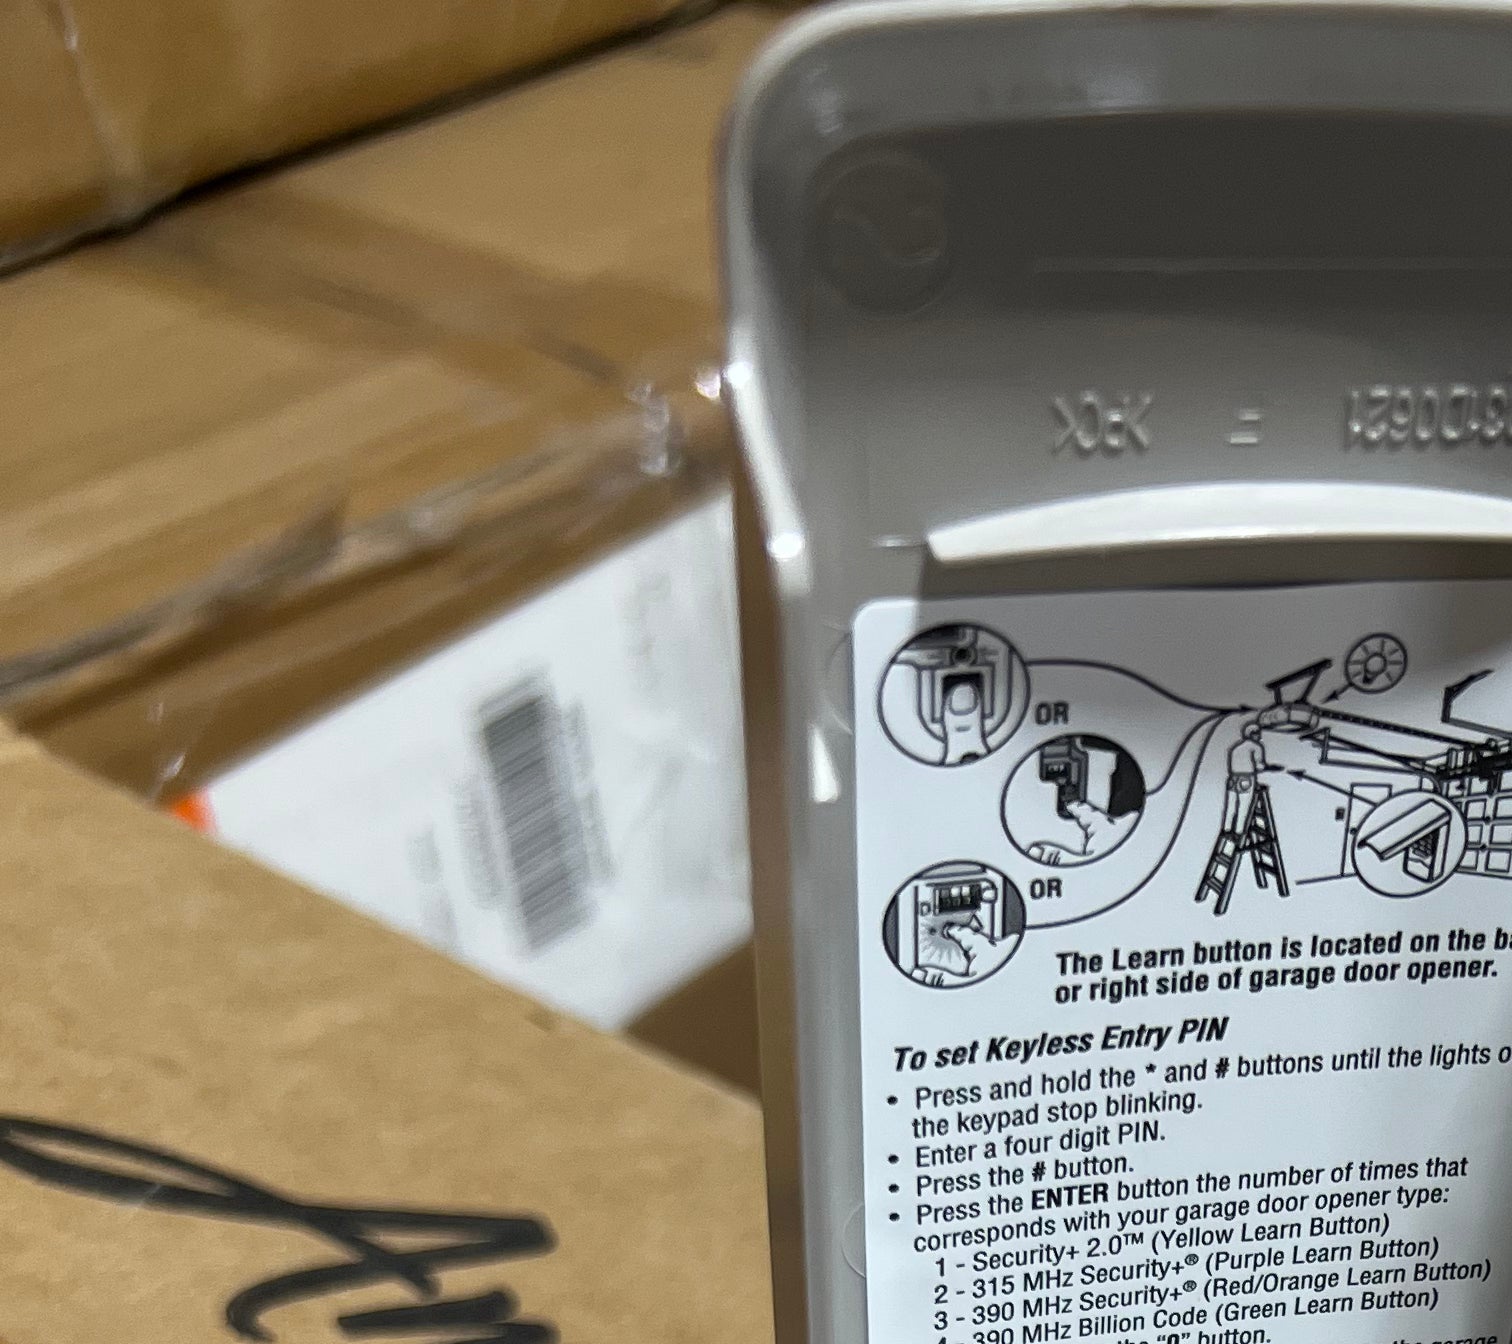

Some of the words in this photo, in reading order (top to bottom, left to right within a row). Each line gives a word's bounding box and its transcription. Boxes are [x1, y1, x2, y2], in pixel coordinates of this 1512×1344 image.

[1035, 702, 1069, 728] OR
[1030, 876, 1063, 901] OR
[1054, 951, 1104, 977] The
[1111, 947, 1185, 972] Learn
[1193, 939, 1273, 965] button
[1280, 936, 1303, 959] is
[1310, 930, 1404, 958] located
[1409, 934, 1441, 953] on
[1447, 928, 1487, 952] the
[1054, 983, 1083, 1005] or
[1089, 974, 1149, 1005] right
[1155, 970, 1210, 996] side
[1217, 966, 1243, 991] of
[1248, 965, 1336, 994] garage
[1343, 960, 1402, 983] door
[1406, 959, 1499, 985] opener.
[893, 1046, 928, 1073] To
[934, 1039, 980, 1069] set
[985, 1032, 1095, 1065] Keyless
[1100, 1024, 1173, 1053] Entry
[1177, 1017, 1230, 1045] PIN
[915, 1084, 982, 1111] Press
[989, 1073, 1033, 1101] and
[1040, 1068, 1092, 1096] hold
[1098, 1066, 1136, 1090] the
[1164, 1059, 1208, 1084] and
[1214, 1057, 1230, 1079] #
[1236, 1054, 1324, 1078] buttons
[1331, 1047, 1382, 1072] until
[1387, 1046, 1423, 1069] the
[1429, 1042, 1492, 1071] lights
[911, 1115, 949, 1139] the
[957, 1102, 1040, 1136] keypad
[1046, 1100, 1098, 1125] stop
[1105, 1091, 1203, 1118] blinking.
[915, 1143, 978, 1169] Enter
[983, 1141, 997, 1160] a
[1003, 1134, 1054, 1157] four
[1059, 1125, 1111, 1153] digit
[1117, 1121, 1166, 1145] PIN.
[916, 1172, 981, 1198] Press
[987, 1165, 1024, 1188] the
[1031, 1160, 1047, 1183] #
[1053, 1155, 1135, 1180] button.
